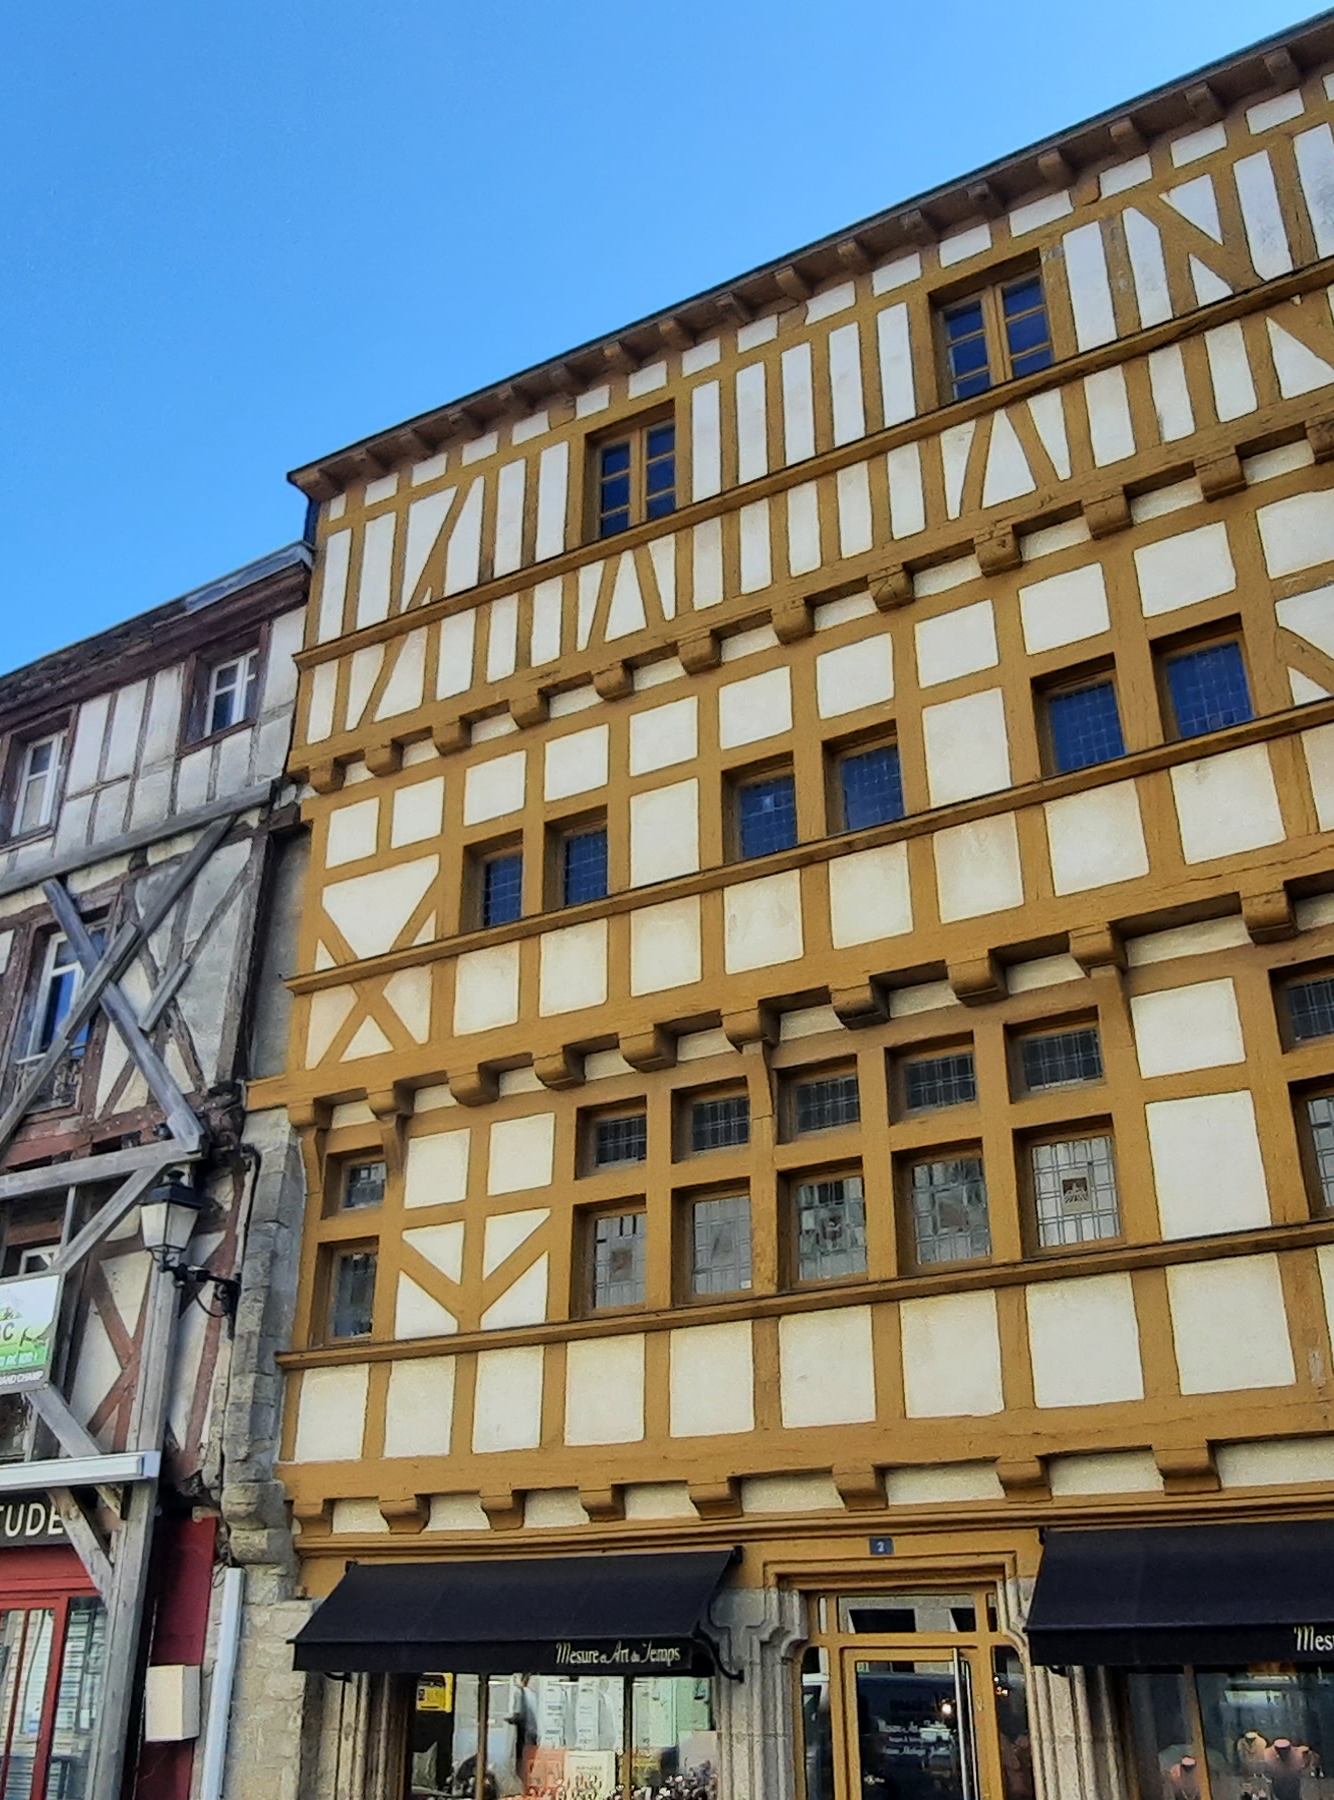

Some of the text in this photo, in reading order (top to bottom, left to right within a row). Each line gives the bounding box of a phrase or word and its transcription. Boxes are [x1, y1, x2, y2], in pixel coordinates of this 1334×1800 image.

[556, 1641, 599, 1664] Mesure
[606, 1640, 629, 1664] Art
[640, 1640, 681, 1667] Temps
